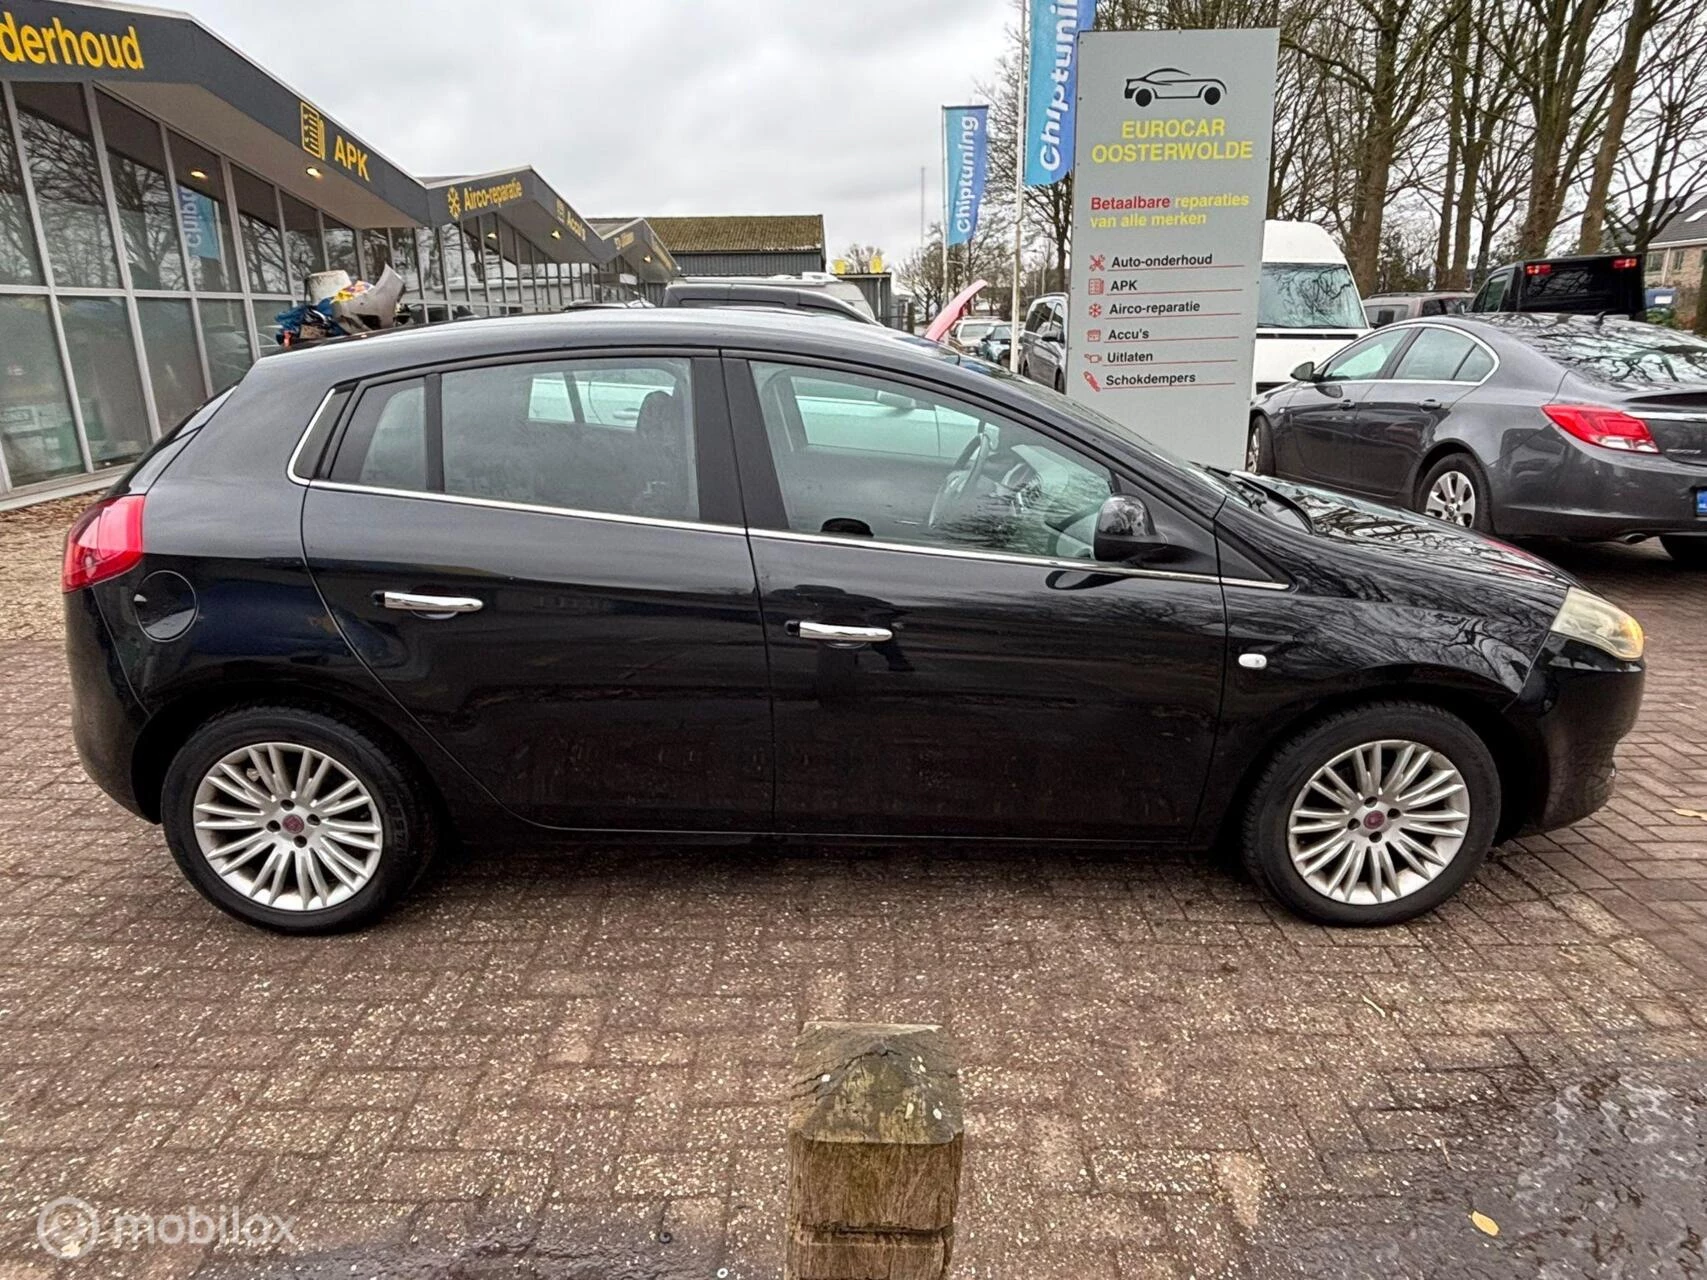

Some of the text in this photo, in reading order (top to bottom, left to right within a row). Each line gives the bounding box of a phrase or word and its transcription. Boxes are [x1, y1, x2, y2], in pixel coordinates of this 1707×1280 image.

[0, 11, 144, 69] derhoud
[1121, 118, 1225, 138] EUROCAR
[334, 135, 370, 182] APK
[1091, 141, 1254, 163] OOSTERWOLDE
[1090, 193, 1249, 210] Betaalbare reparaties
[1090, 212, 1207, 228] van alle merken
[1111, 253, 1213, 268] Auto-onderhoud
[1110, 280, 1138, 291] APK
[1109, 300, 1201, 316] Airco-reparatie
[1108, 328, 1150, 340] Accu's
[1106, 352, 1154, 363] Uitlaten
[1105, 373, 1196, 387] Schokdempers
